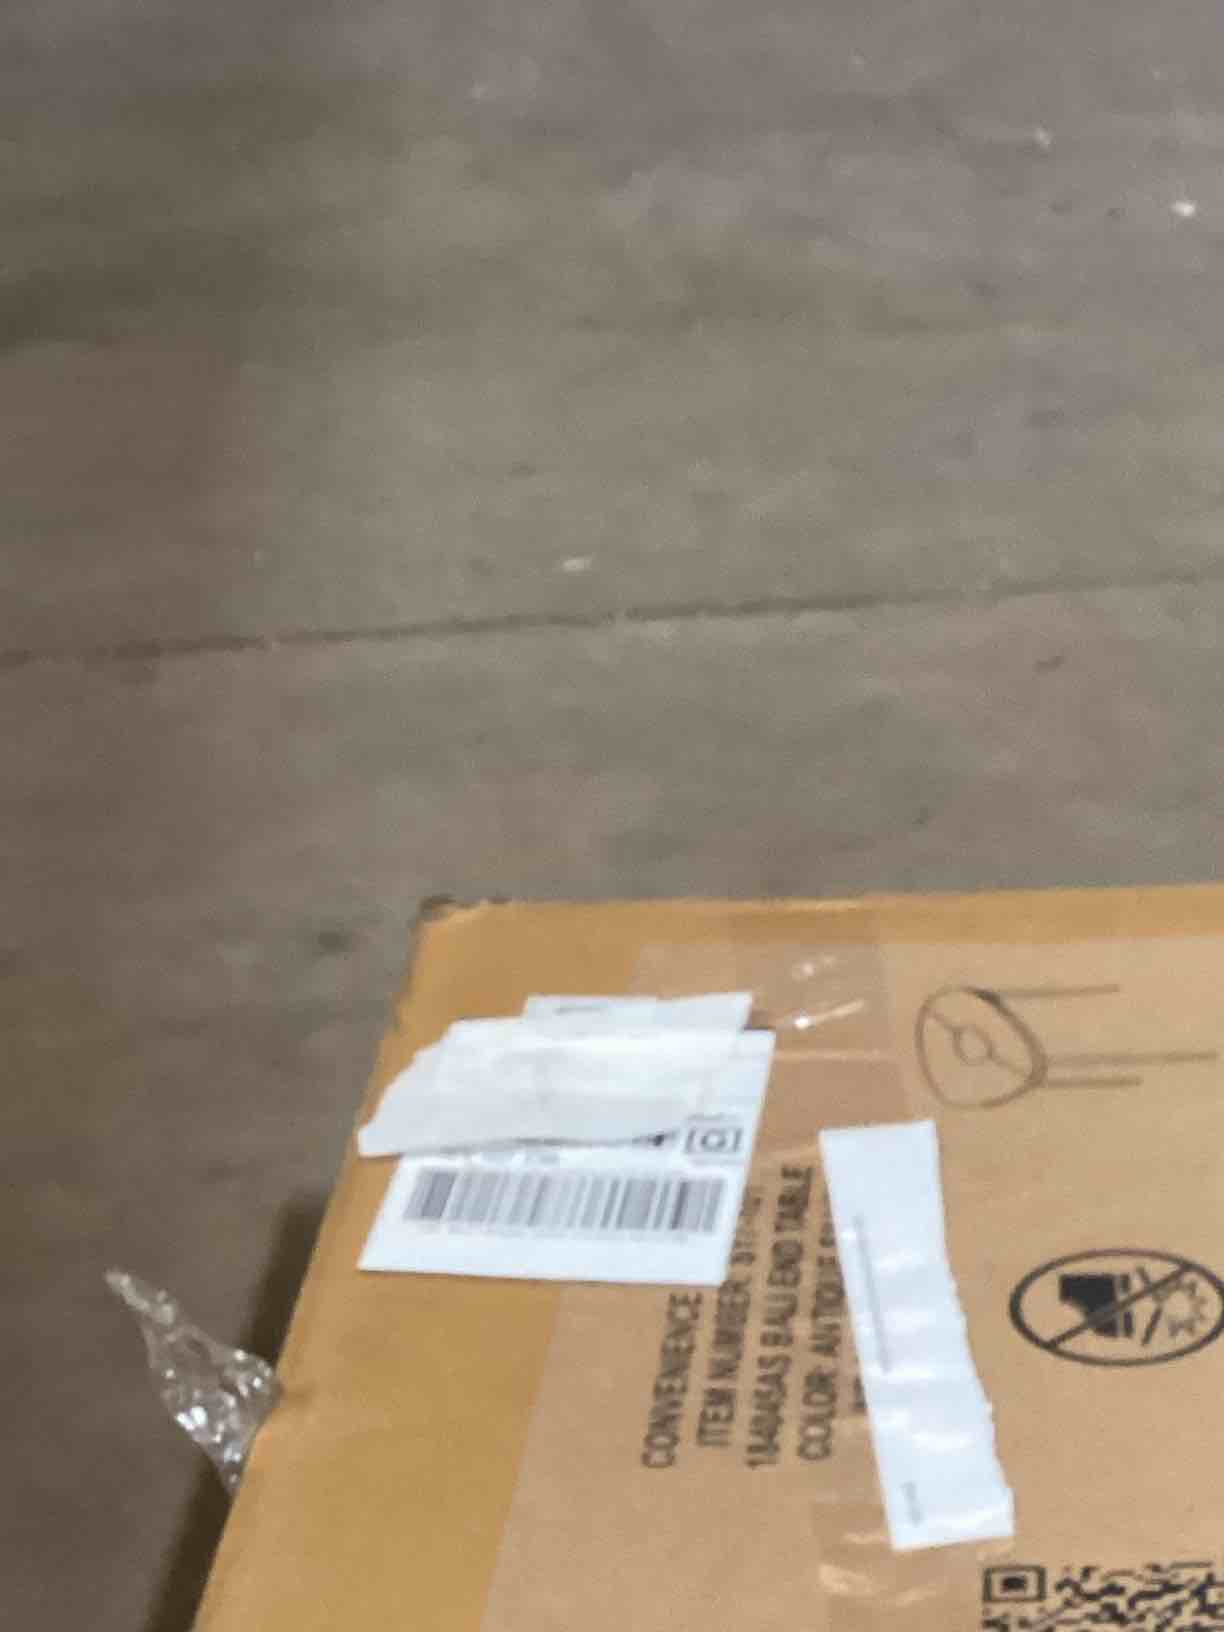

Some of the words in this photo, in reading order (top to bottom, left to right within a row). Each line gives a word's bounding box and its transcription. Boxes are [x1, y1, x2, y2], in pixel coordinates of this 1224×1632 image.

[773, 1165, 813, 1232] TABLE
[768, 1240, 803, 1287] END
[760, 1294, 798, 1347] BALI
[641, 1293, 701, 1469] CONVENIENCE
[696, 1388, 735, 1446] ITEM
